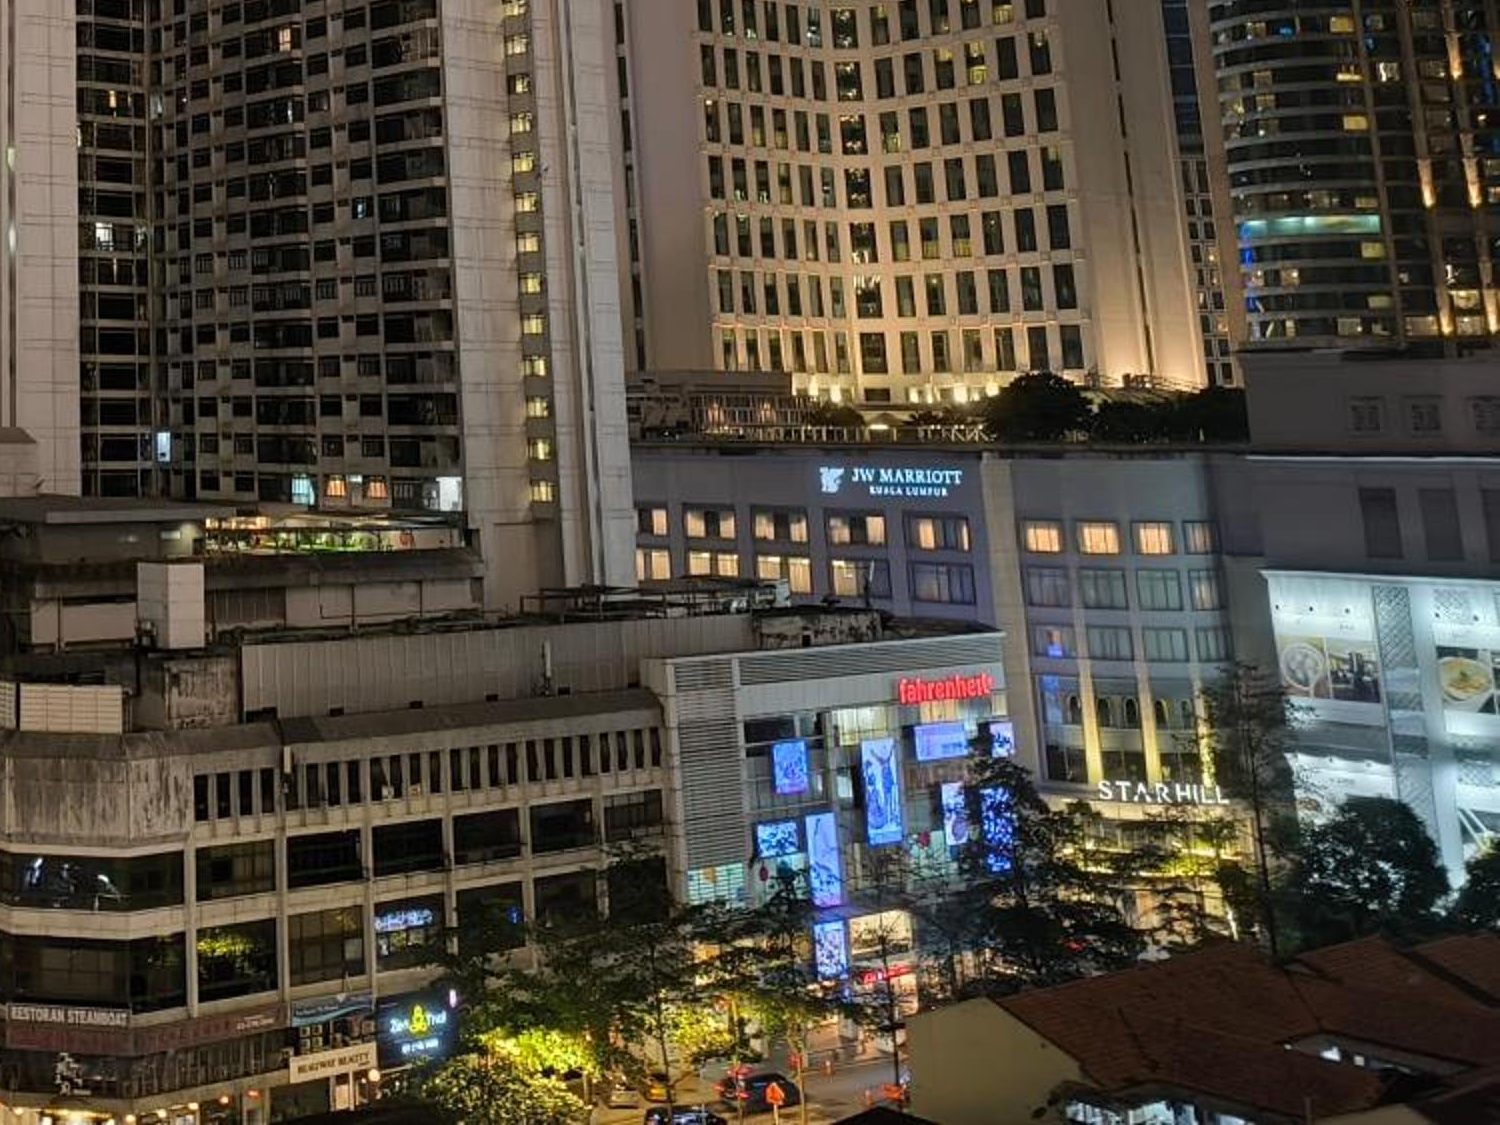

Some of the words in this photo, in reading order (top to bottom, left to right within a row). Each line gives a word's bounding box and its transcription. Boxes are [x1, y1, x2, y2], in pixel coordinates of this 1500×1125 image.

[851, 467, 876, 482] JW
[879, 468, 963, 485] MARRIOTT
[868, 485, 903, 496] KUALA
[905, 486, 949, 497] LUMPUR
[1097, 779, 1231, 805] STARHILL
[67, 1009, 128, 1027] STEAMBOAT
